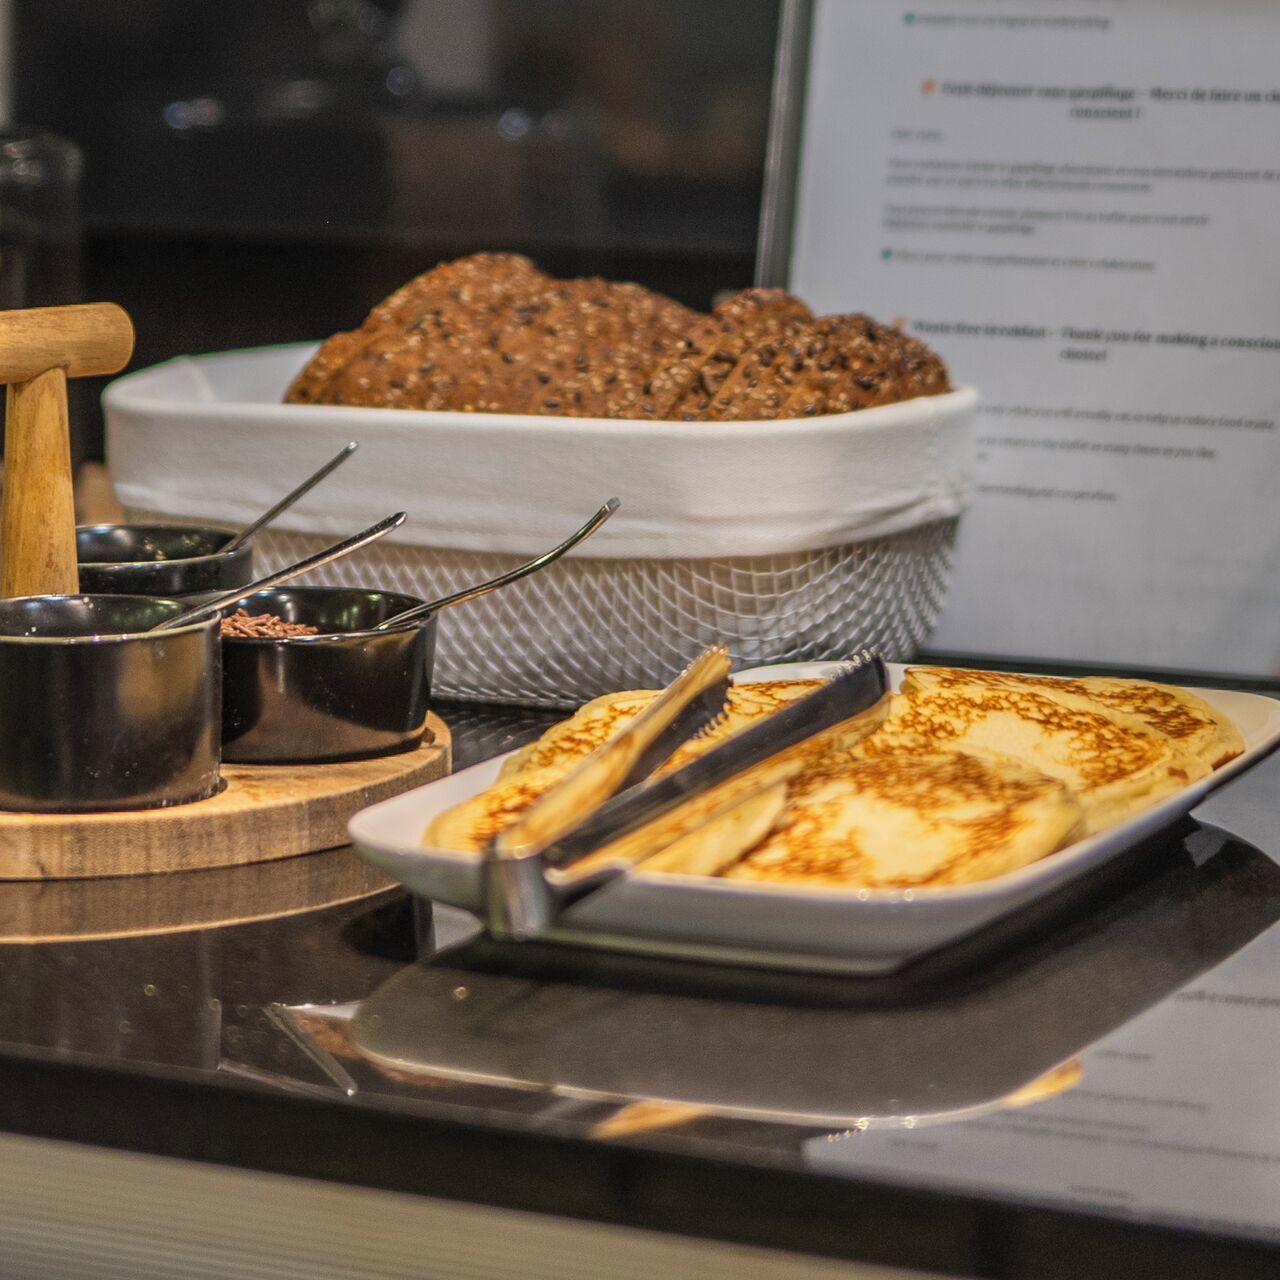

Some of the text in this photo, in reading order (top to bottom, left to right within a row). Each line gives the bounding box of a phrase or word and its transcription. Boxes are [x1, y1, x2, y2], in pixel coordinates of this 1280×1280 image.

[1148, 86, 1187, 101] Merci
[1190, 87, 1206, 101] de
[1209, 87, 1240, 102] faire
[1244, 91, 1261, 103] un
[1059, 326, 1102, 342] Thank
[1104, 330, 1130, 345] you
[1132, 329, 1152, 343] for
[1155, 331, 1207, 349] making
